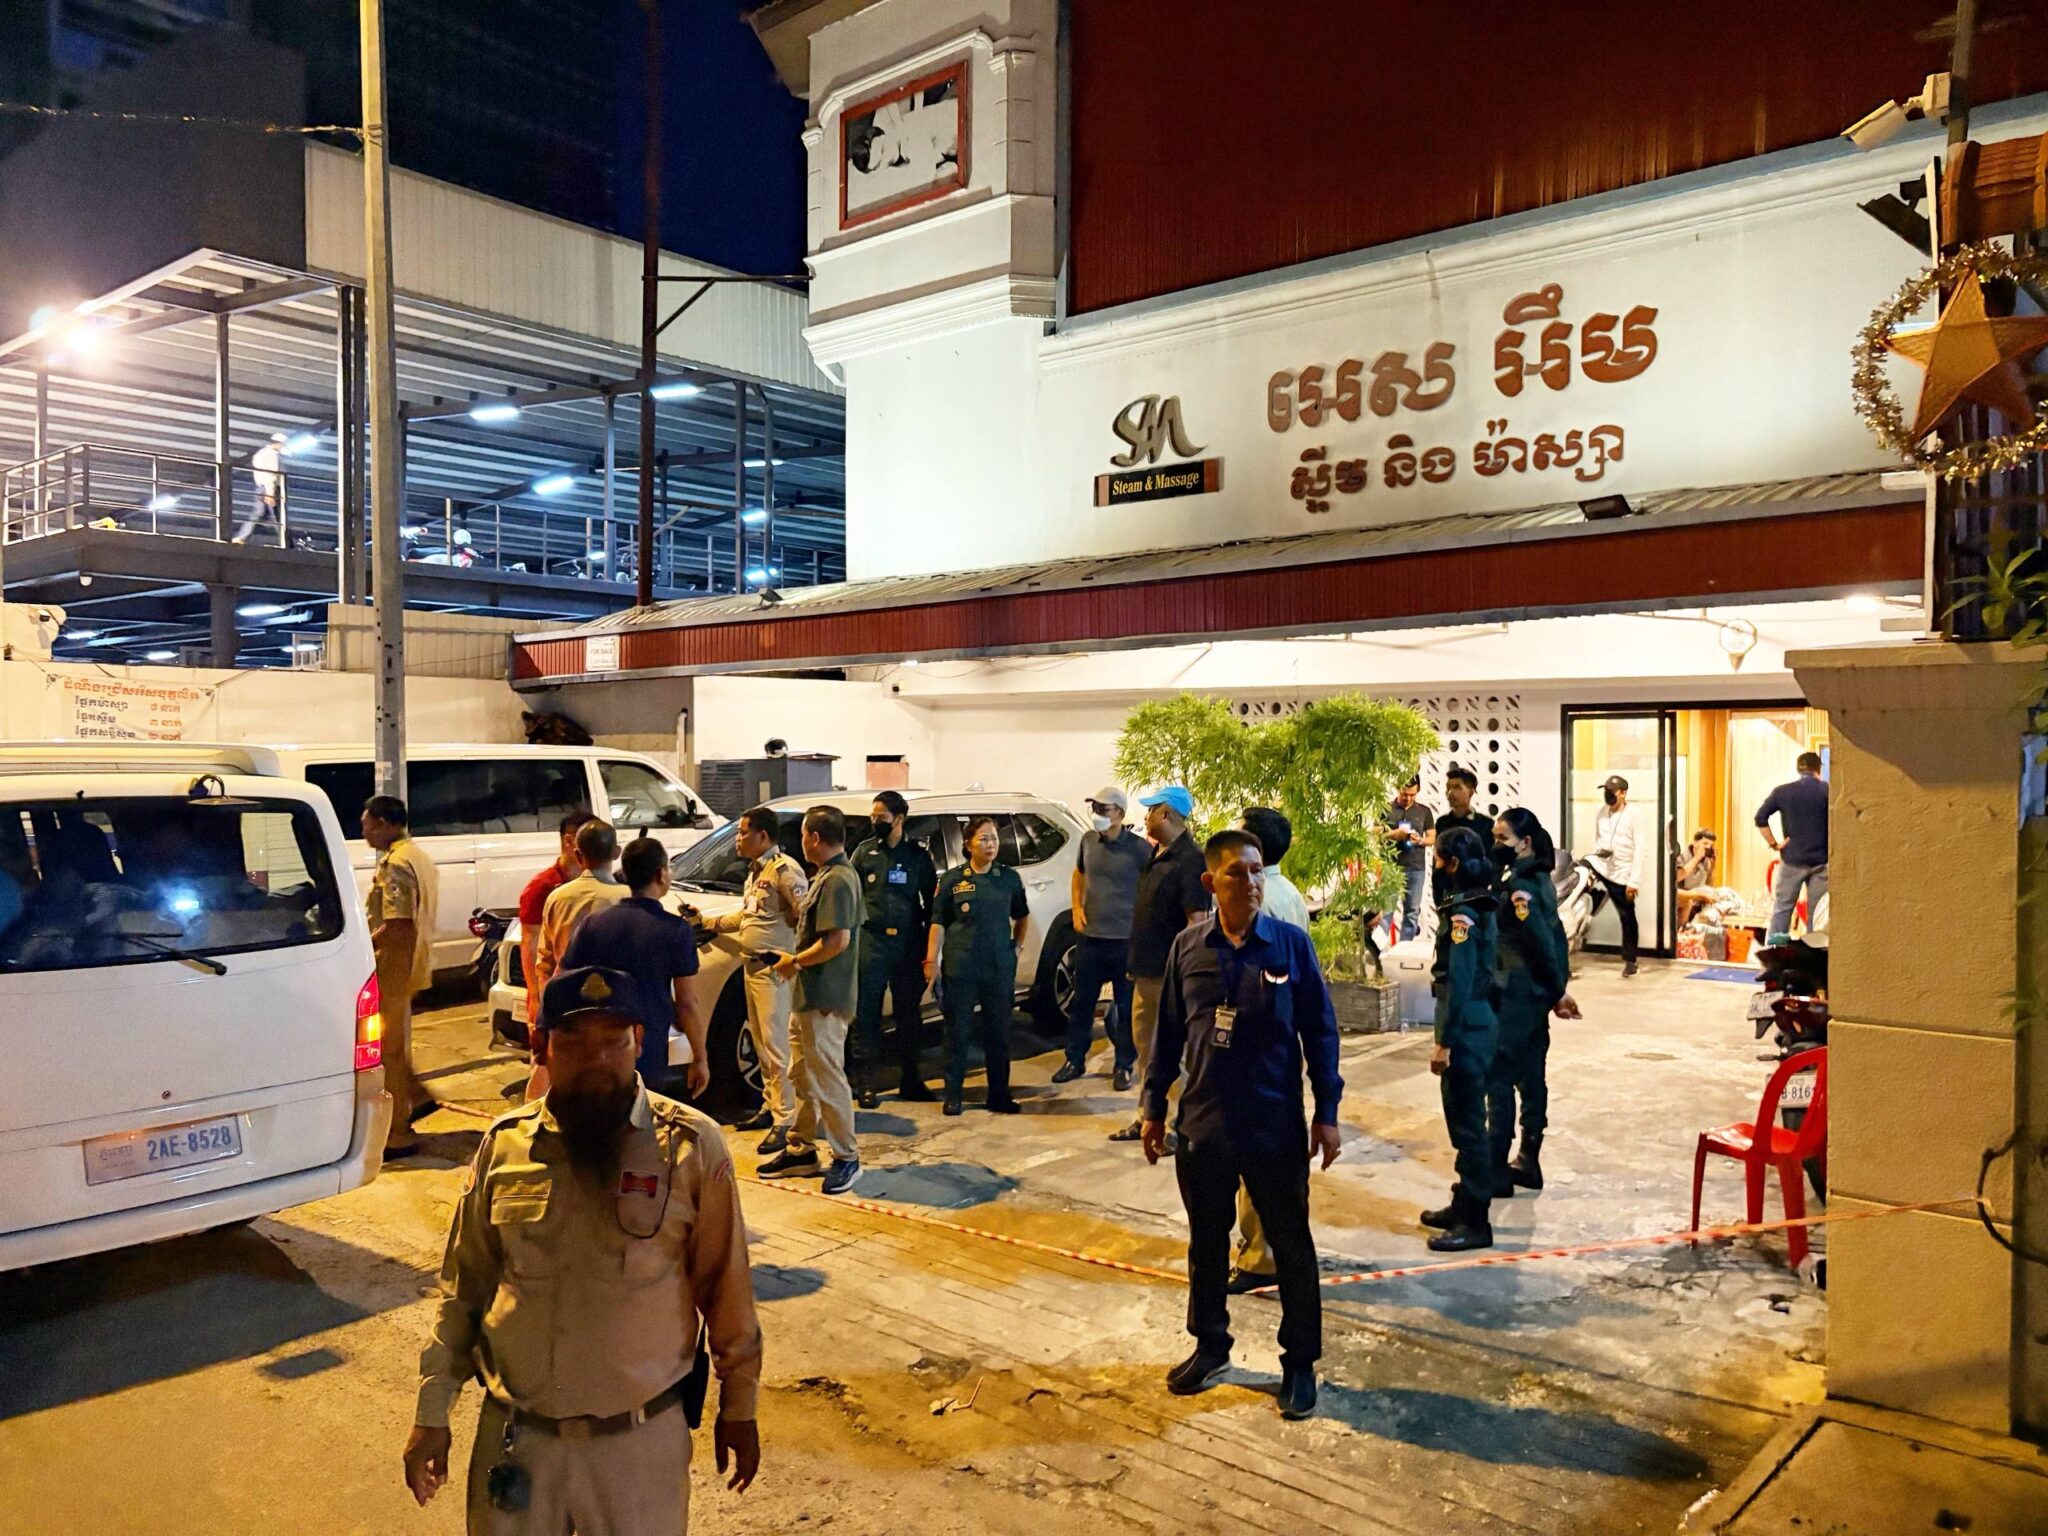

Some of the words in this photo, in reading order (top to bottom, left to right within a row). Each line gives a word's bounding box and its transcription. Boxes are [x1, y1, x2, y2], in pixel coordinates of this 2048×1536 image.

[1267, 340, 1456, 433] អេស
[1110, 393, 1209, 468] SM
[1384, 433, 1456, 488] និង
[1473, 418, 1625, 482] ម៉ាស្សា
[1112, 479, 1143, 496] Steam
[1144, 476, 1153, 491] &
[1154, 472, 1200, 489] Massage
[601, 647, 613, 655] SALE
[146, 1125, 232, 1161] 2AE-8528
